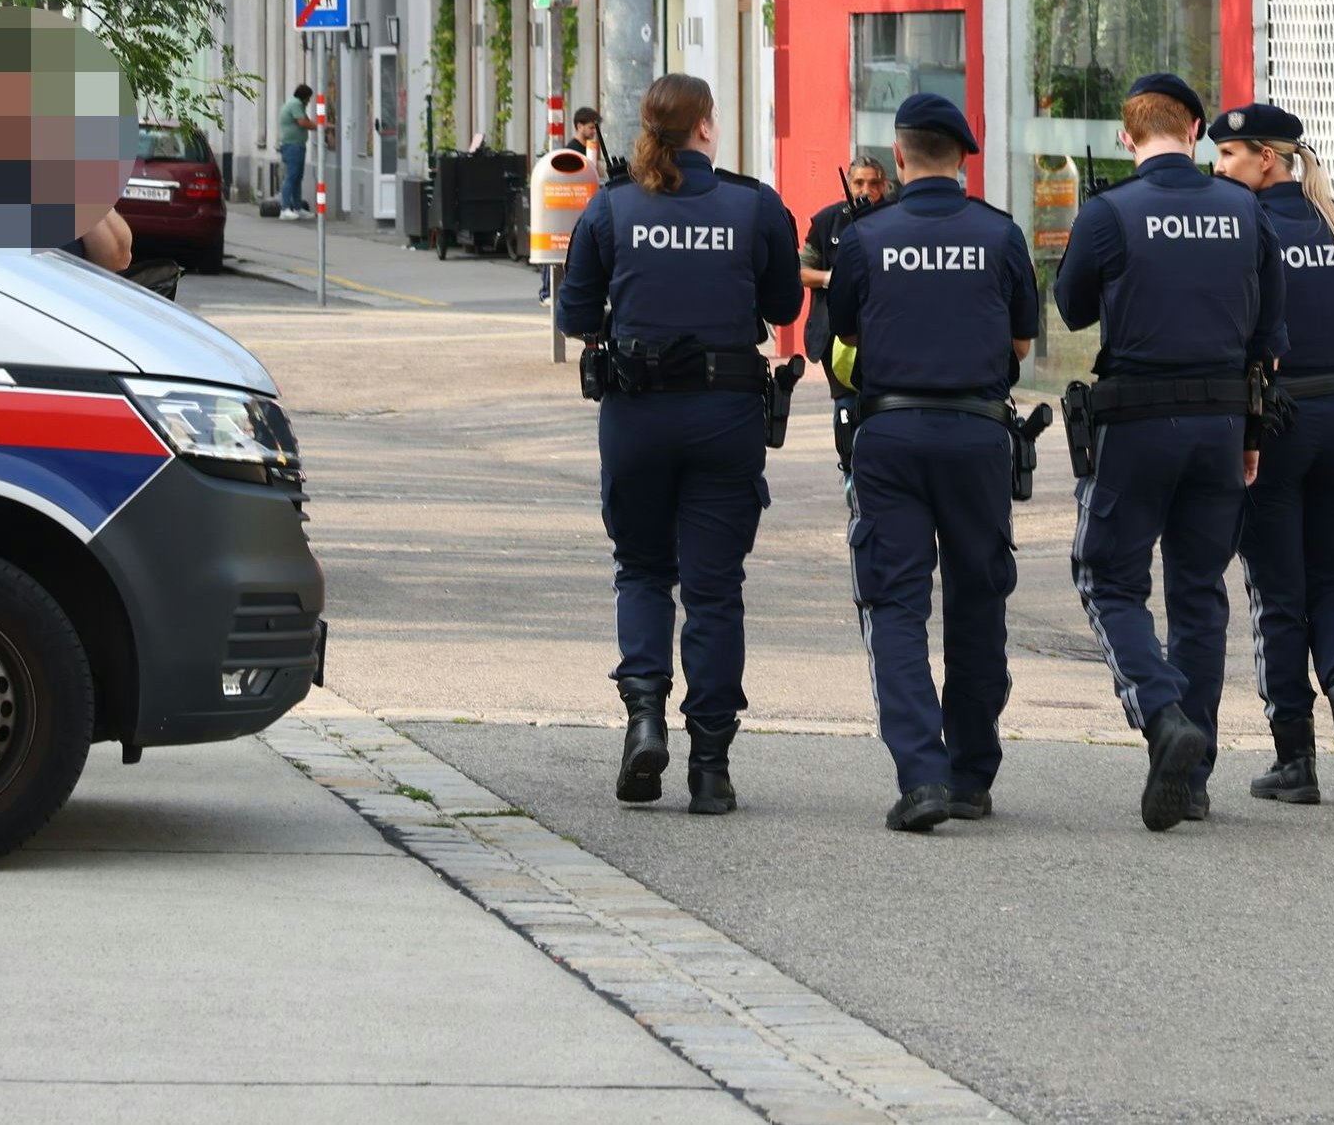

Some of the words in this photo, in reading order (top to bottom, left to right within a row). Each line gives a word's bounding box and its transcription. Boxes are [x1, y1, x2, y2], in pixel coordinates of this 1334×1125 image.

[633, 225, 734, 251] POLIZEI
[1146, 216, 1240, 240] POLIZEI
[883, 246, 985, 272] POLIZEI
